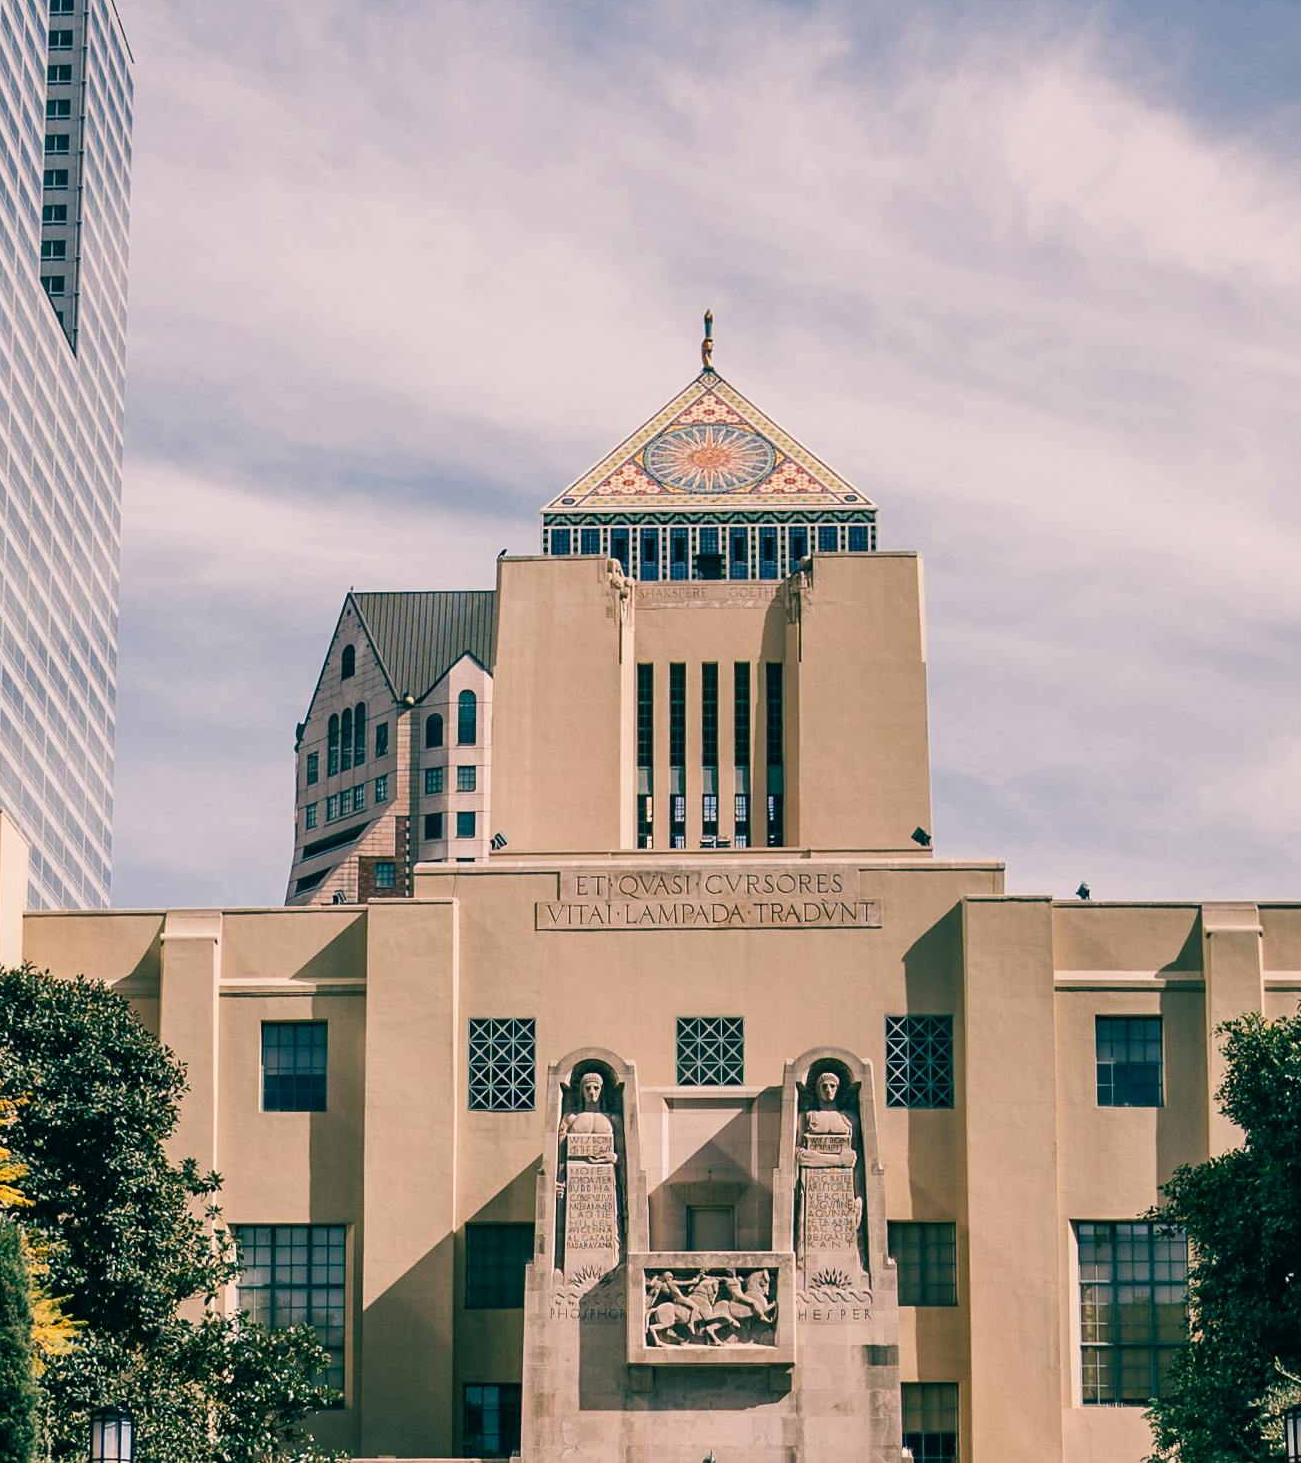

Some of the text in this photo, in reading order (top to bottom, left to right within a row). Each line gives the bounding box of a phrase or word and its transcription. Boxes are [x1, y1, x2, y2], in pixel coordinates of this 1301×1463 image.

[638, 587, 708, 599] SHAKSPERE
[575, 873, 843, 899] ET QVASI CVRSORES
[547, 901, 876, 925] VITAI LAMPADA TRADVNT
[808, 1241, 852, 1249] KANT
[549, 1308, 627, 1321] PHOSPHOR
[797, 1308, 873, 1321] HESPER
